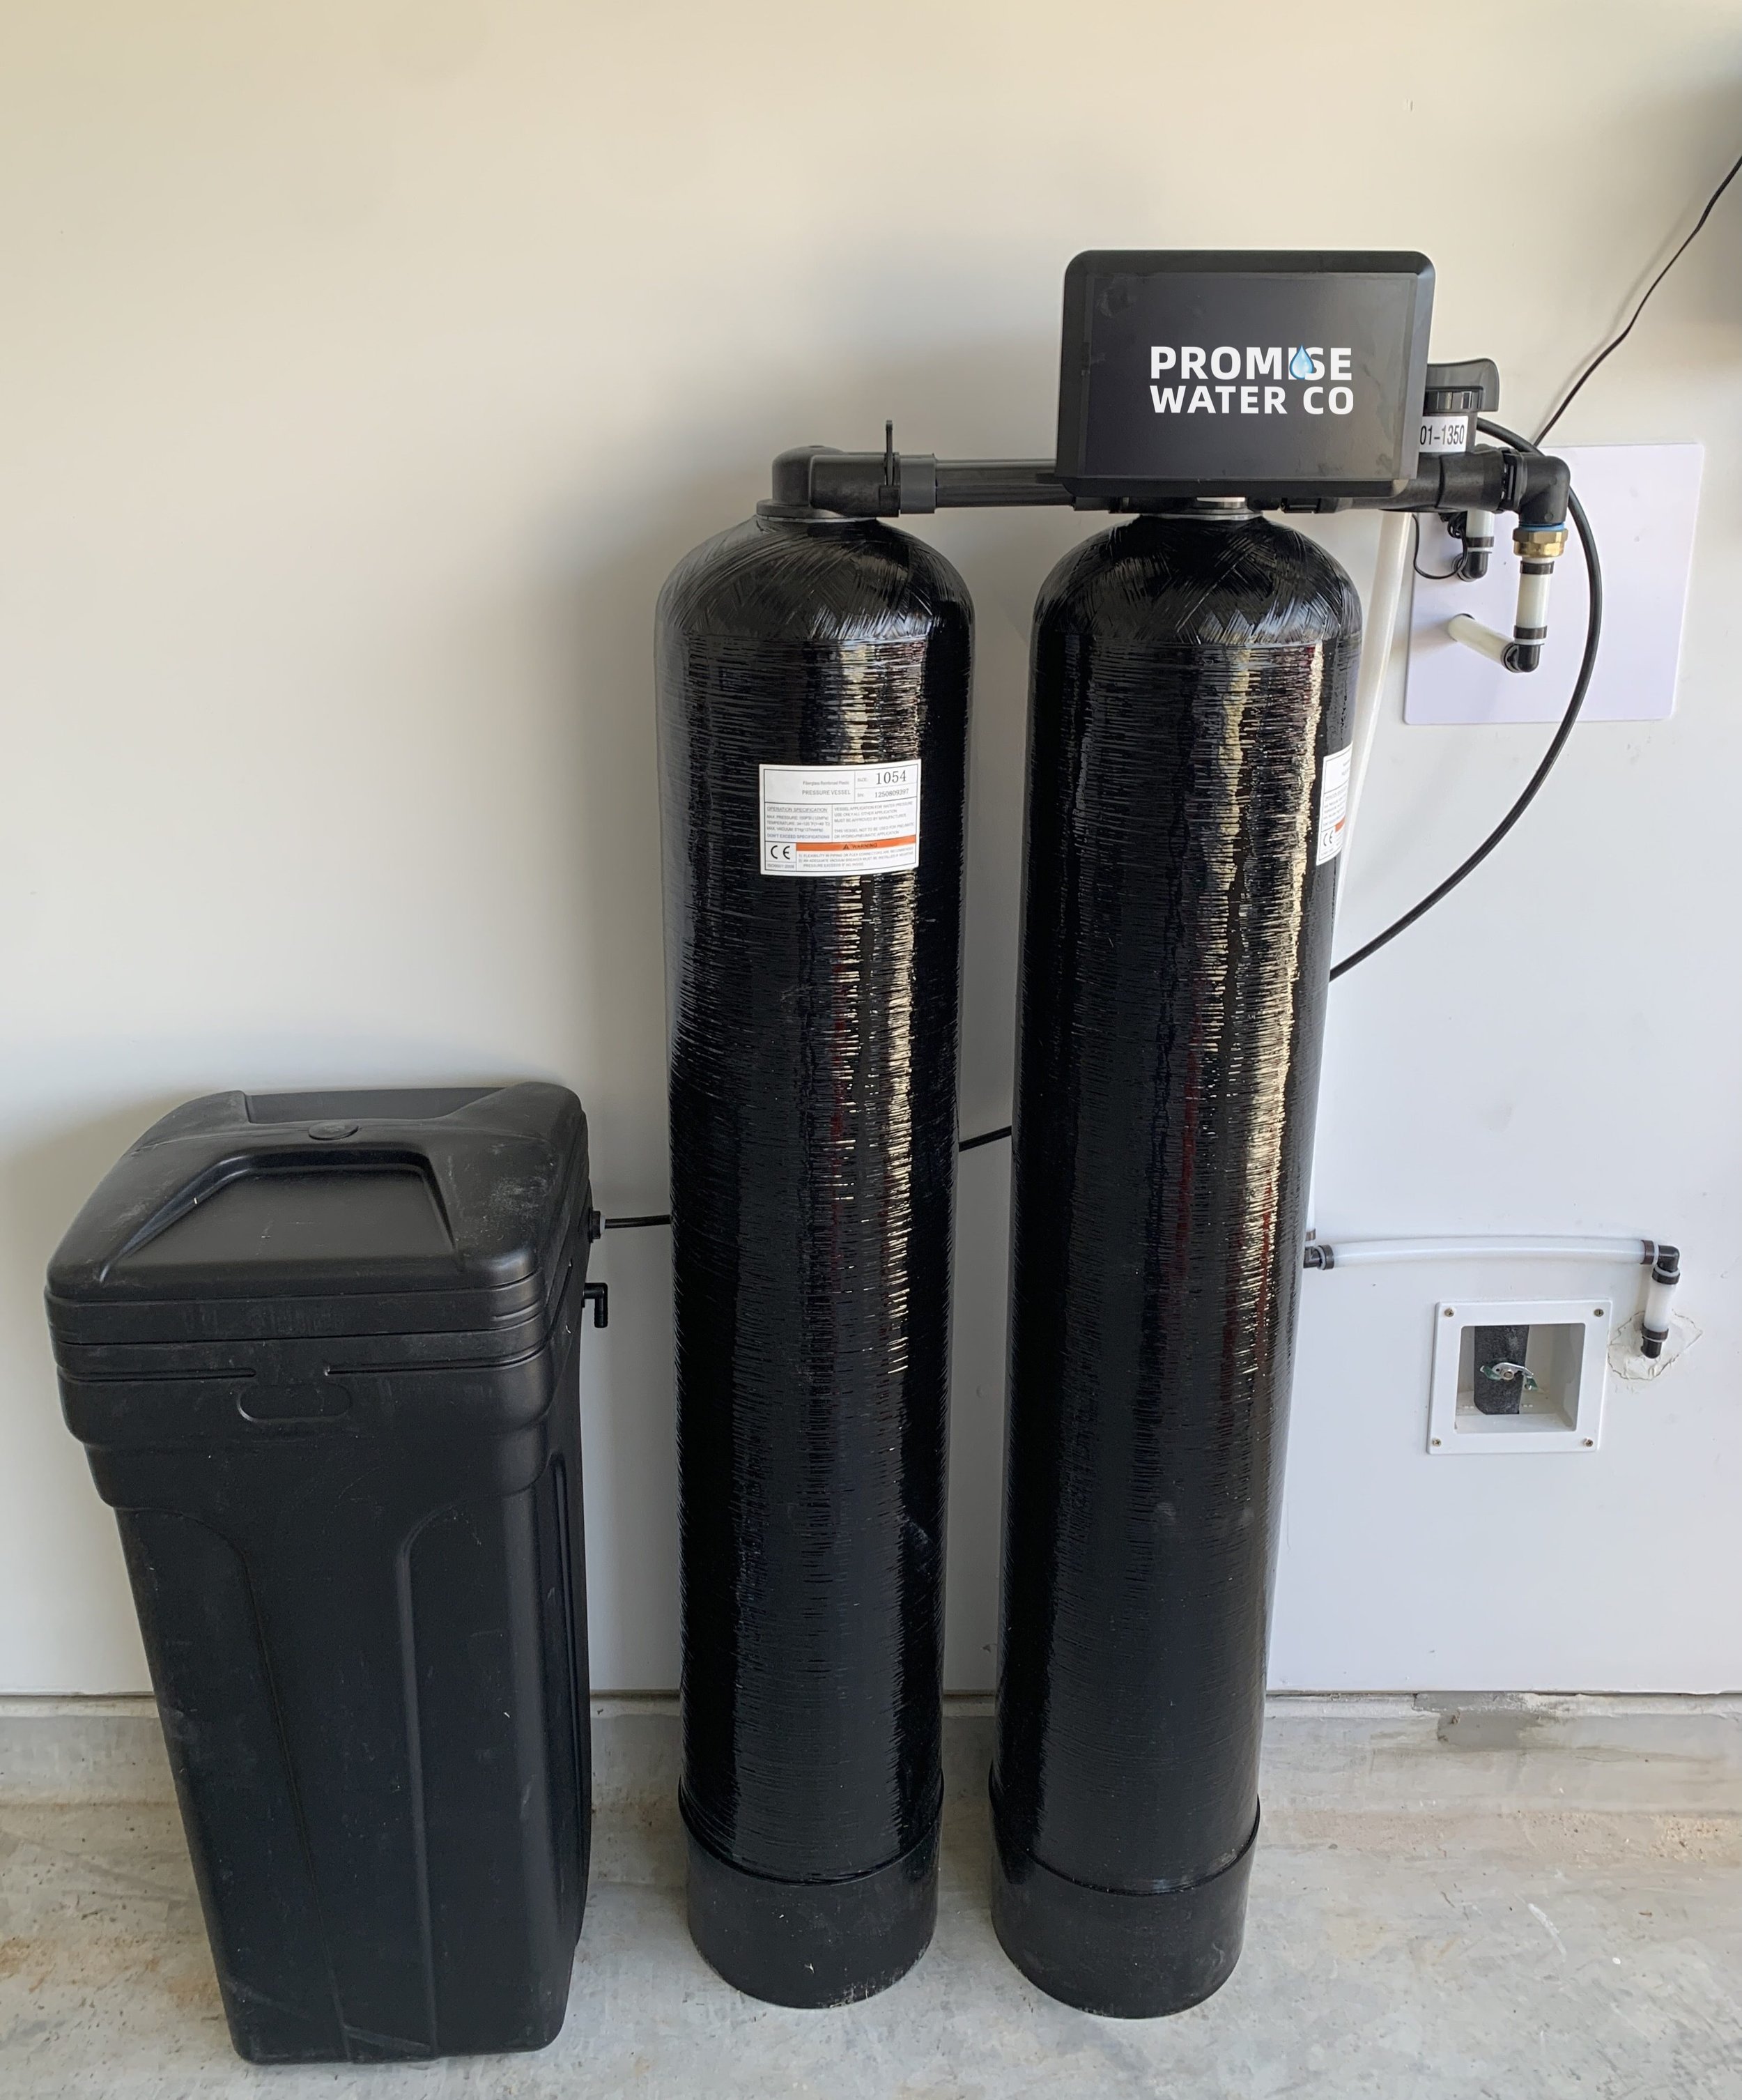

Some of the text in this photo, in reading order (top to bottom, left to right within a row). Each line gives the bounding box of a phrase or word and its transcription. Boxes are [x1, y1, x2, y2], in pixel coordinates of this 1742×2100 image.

[1150, 345, 1352, 381] PROMISE
[1150, 385, 1354, 415] WATER CO
[876, 769, 907, 785] 1054
[771, 845, 790, 860] CE
